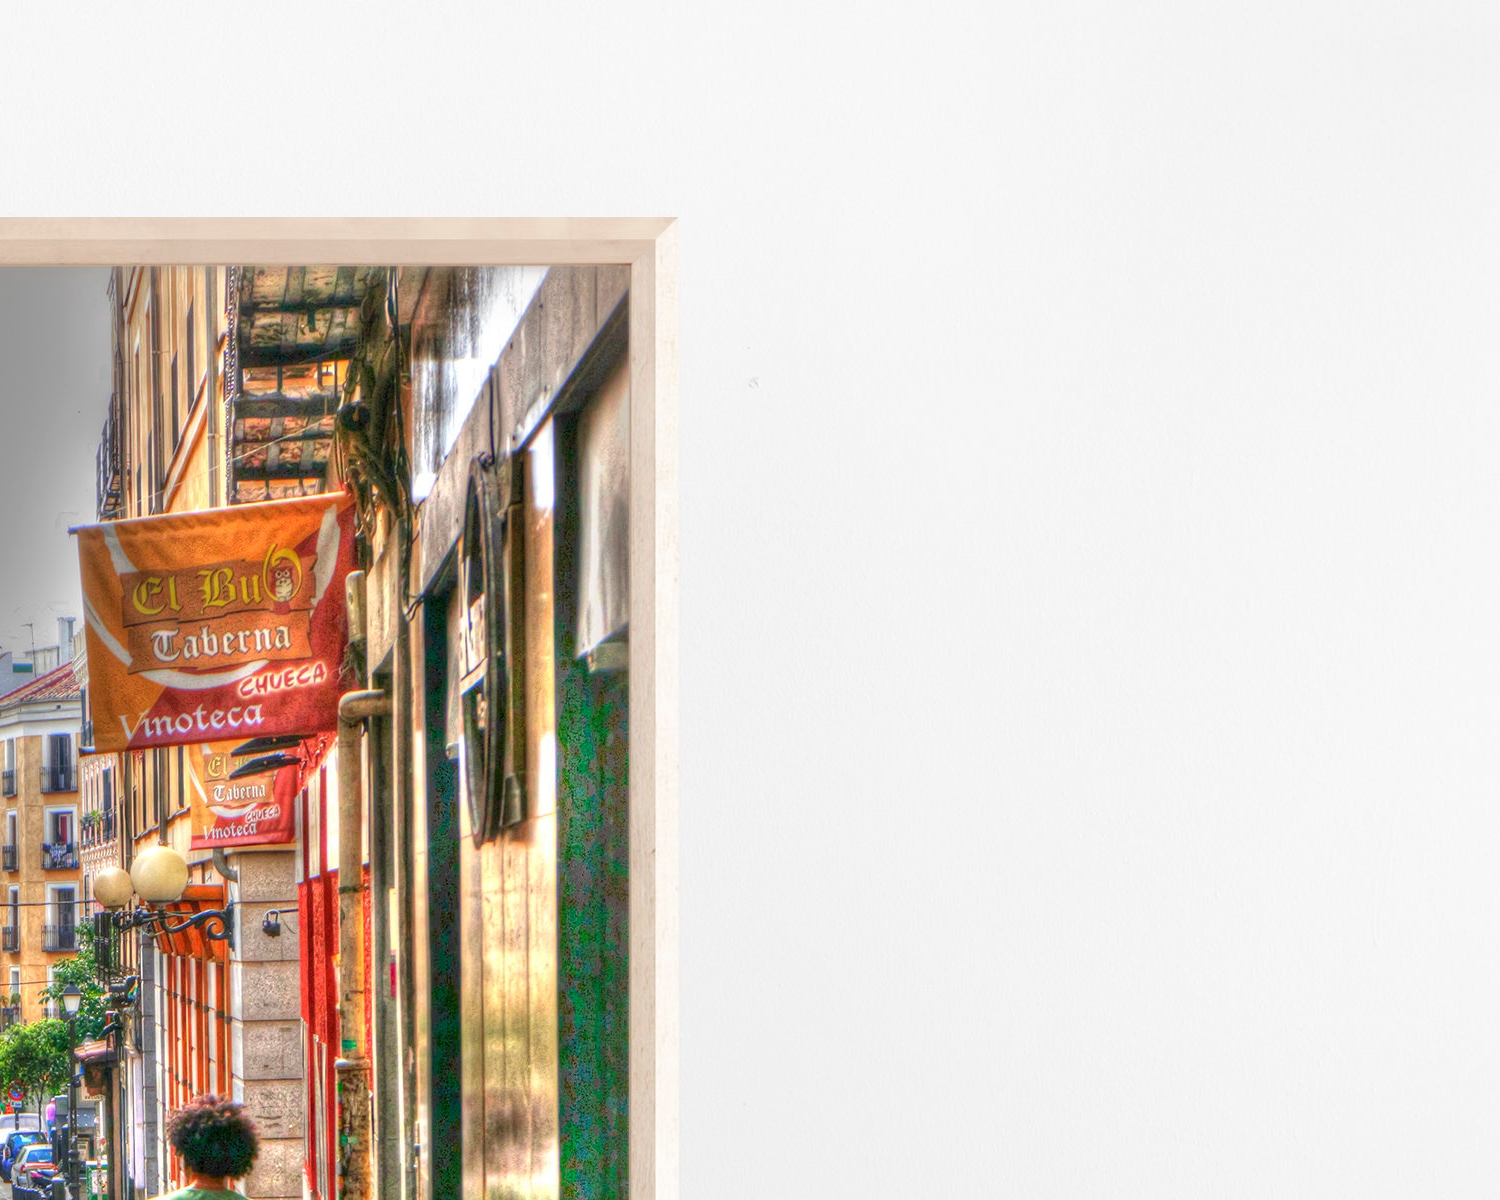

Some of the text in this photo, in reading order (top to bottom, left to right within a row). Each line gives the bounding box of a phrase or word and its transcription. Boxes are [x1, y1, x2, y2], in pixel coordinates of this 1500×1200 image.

[132, 576, 183, 615] El
[150, 625, 292, 663] Taberna
[238, 662, 327, 698] CHUECA
[118, 703, 265, 741] Vinoteca
[207, 756, 228, 777] El
[213, 784, 266, 802] Taberna
[246, 806, 280, 822] CHUECA
[203, 823, 257, 840] Vinoteca
